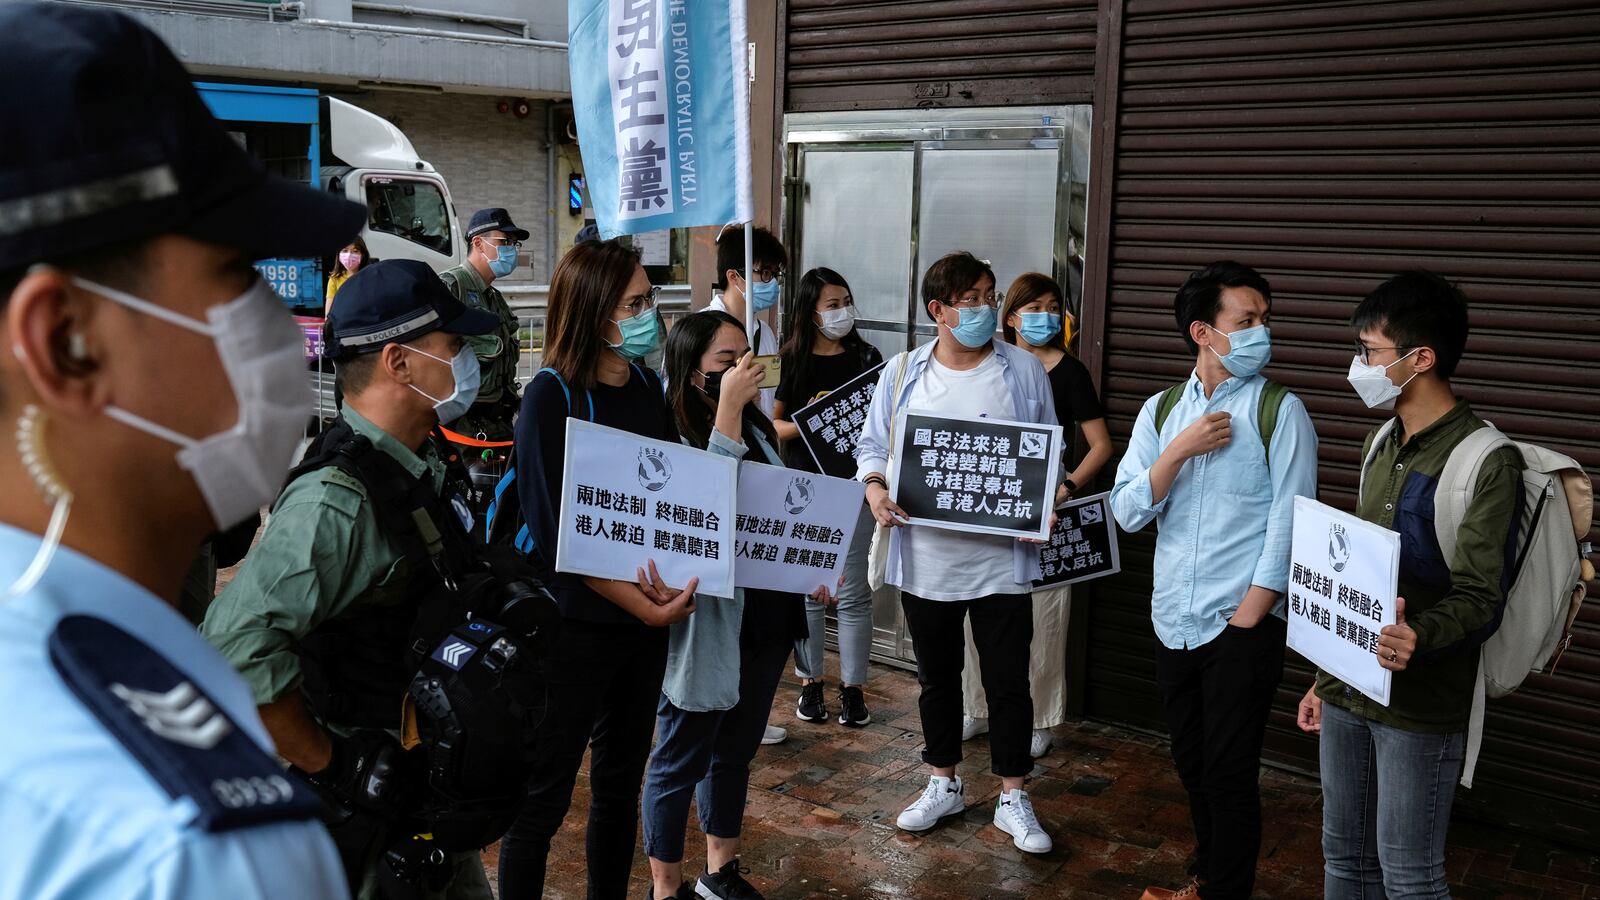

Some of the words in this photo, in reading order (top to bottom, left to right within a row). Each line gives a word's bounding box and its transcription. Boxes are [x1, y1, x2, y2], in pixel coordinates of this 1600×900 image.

[373, 326, 402, 341] POLICE
[913, 428, 1011, 456] 國安法來港
[920, 449, 1017, 477] 香港變新疆
[577, 484, 647, 517] 兩地法制
[655, 500, 720, 532] 終極融合
[935, 491, 1033, 520] 香港人反抗
[575, 514, 645, 546] 港人被迫
[653, 529, 719, 560] 聽黨聽習
[736, 514, 787, 538] 兩地法制
[790, 522, 844, 546] 終極融合
[1040, 527, 1083, 549] 新疆
[783, 546, 838, 570] 聽黨聽習
[1040, 540, 1091, 564] 變秦城
[1291, 562, 1333, 600] 兩地法制
[1337, 582, 1384, 623] 終極融合
[1291, 592, 1331, 631] 港人被迫
[1336, 614, 1380, 655] 聽黨聽習
